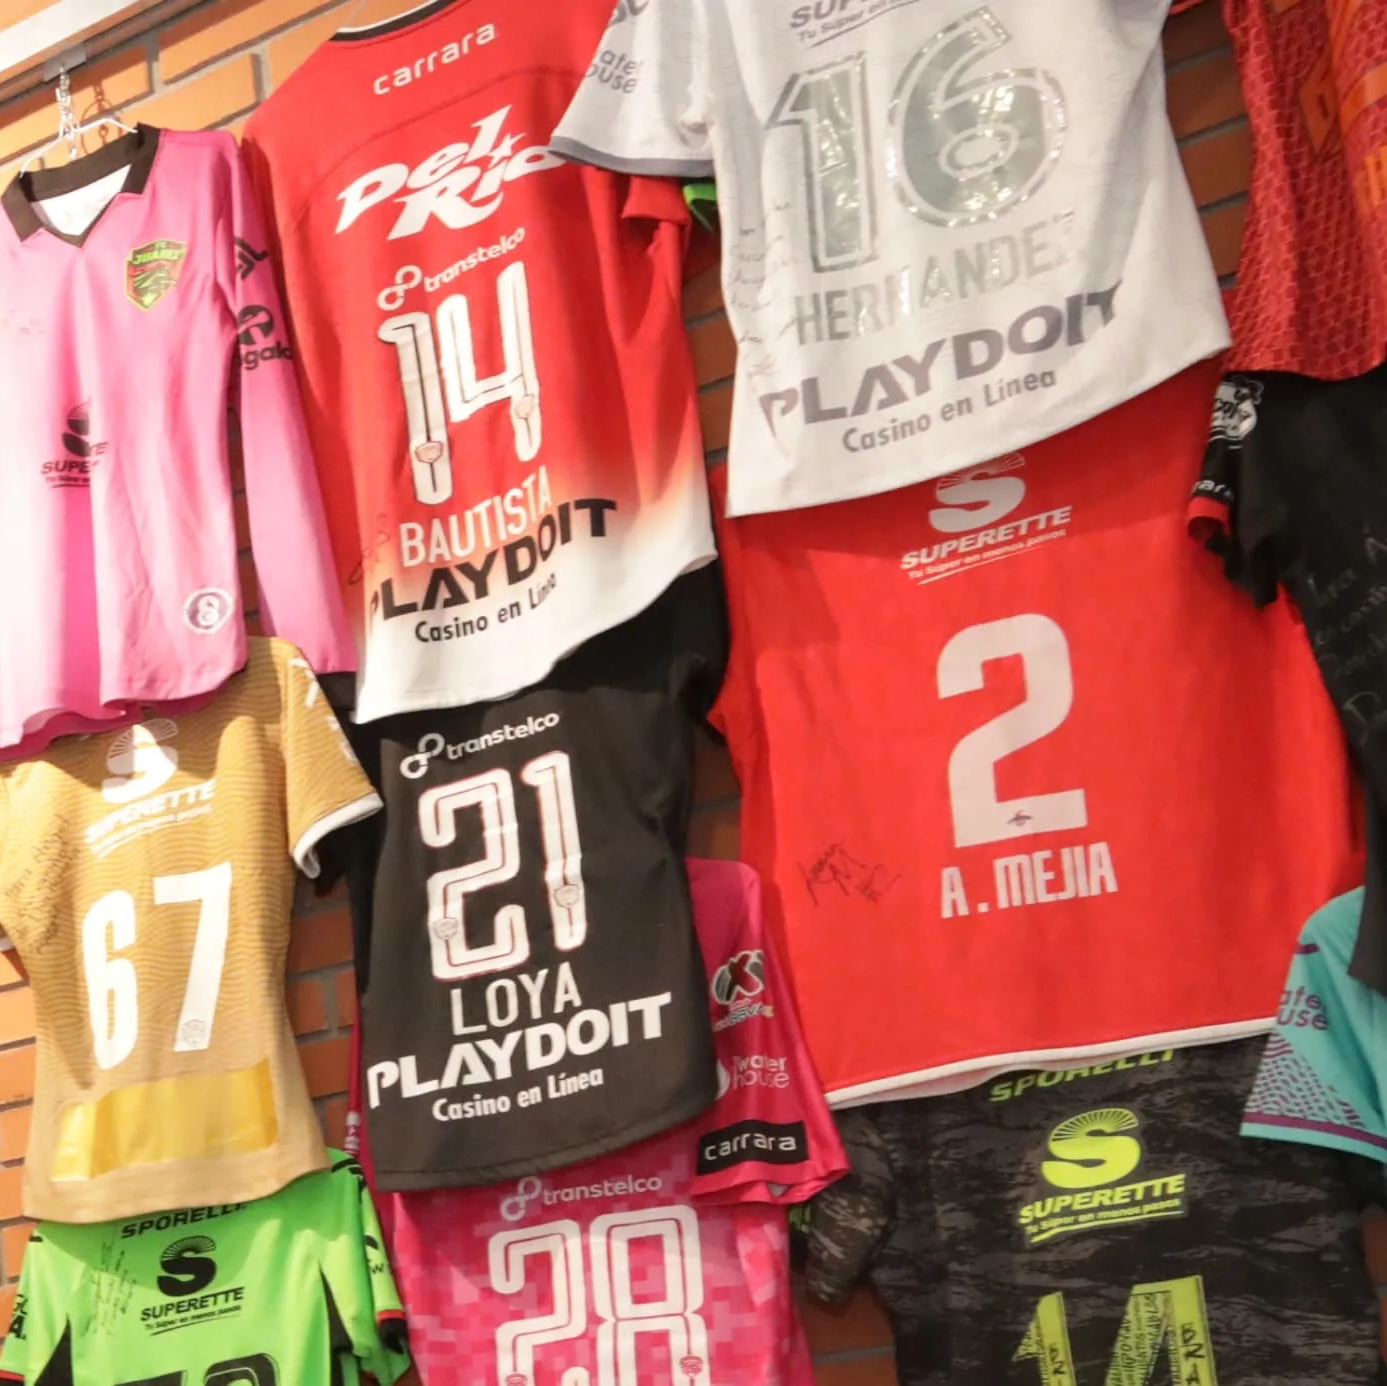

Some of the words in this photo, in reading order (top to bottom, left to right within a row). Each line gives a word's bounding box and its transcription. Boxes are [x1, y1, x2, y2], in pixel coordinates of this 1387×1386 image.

[372, 23, 498, 97] carrara
[334, 104, 514, 235] Del
[764, 5, 1071, 275] 16
[423, 226, 527, 295] transtelco
[792, 208, 1076, 347] HERNANDEZ
[376, 260, 544, 506] 14
[757, 279, 1126, 438] PLAYDOIT
[840, 414, 934, 456] Casino
[938, 396, 977, 424] en
[981, 364, 1059, 412] Línea
[398, 464, 554, 569] BAUTISTA
[899, 504, 1074, 571] SUPERETTE
[414, 609, 490, 644] Casino
[496, 599, 524, 624] en
[446, 711, 562, 762] transtelco
[935, 611, 1089, 849] 2
[416, 749, 588, 983] 21
[993, 840, 1120, 911] MEJIA
[81, 861, 233, 1072] 67
[450, 960, 584, 1037] LOYA
[366, 991, 673, 1110] PLAYDOIT
[431, 1094, 512, 1124] Casino
[515, 1088, 544, 1110] en
[546, 1065, 606, 1102] Línea
[703, 1132, 797, 1161] carrara
[541, 1174, 664, 1208] transtelco
[1017, 1172, 1188, 1225] SUPERETTE
[140, 1286, 245, 1323] SUPERETTE
